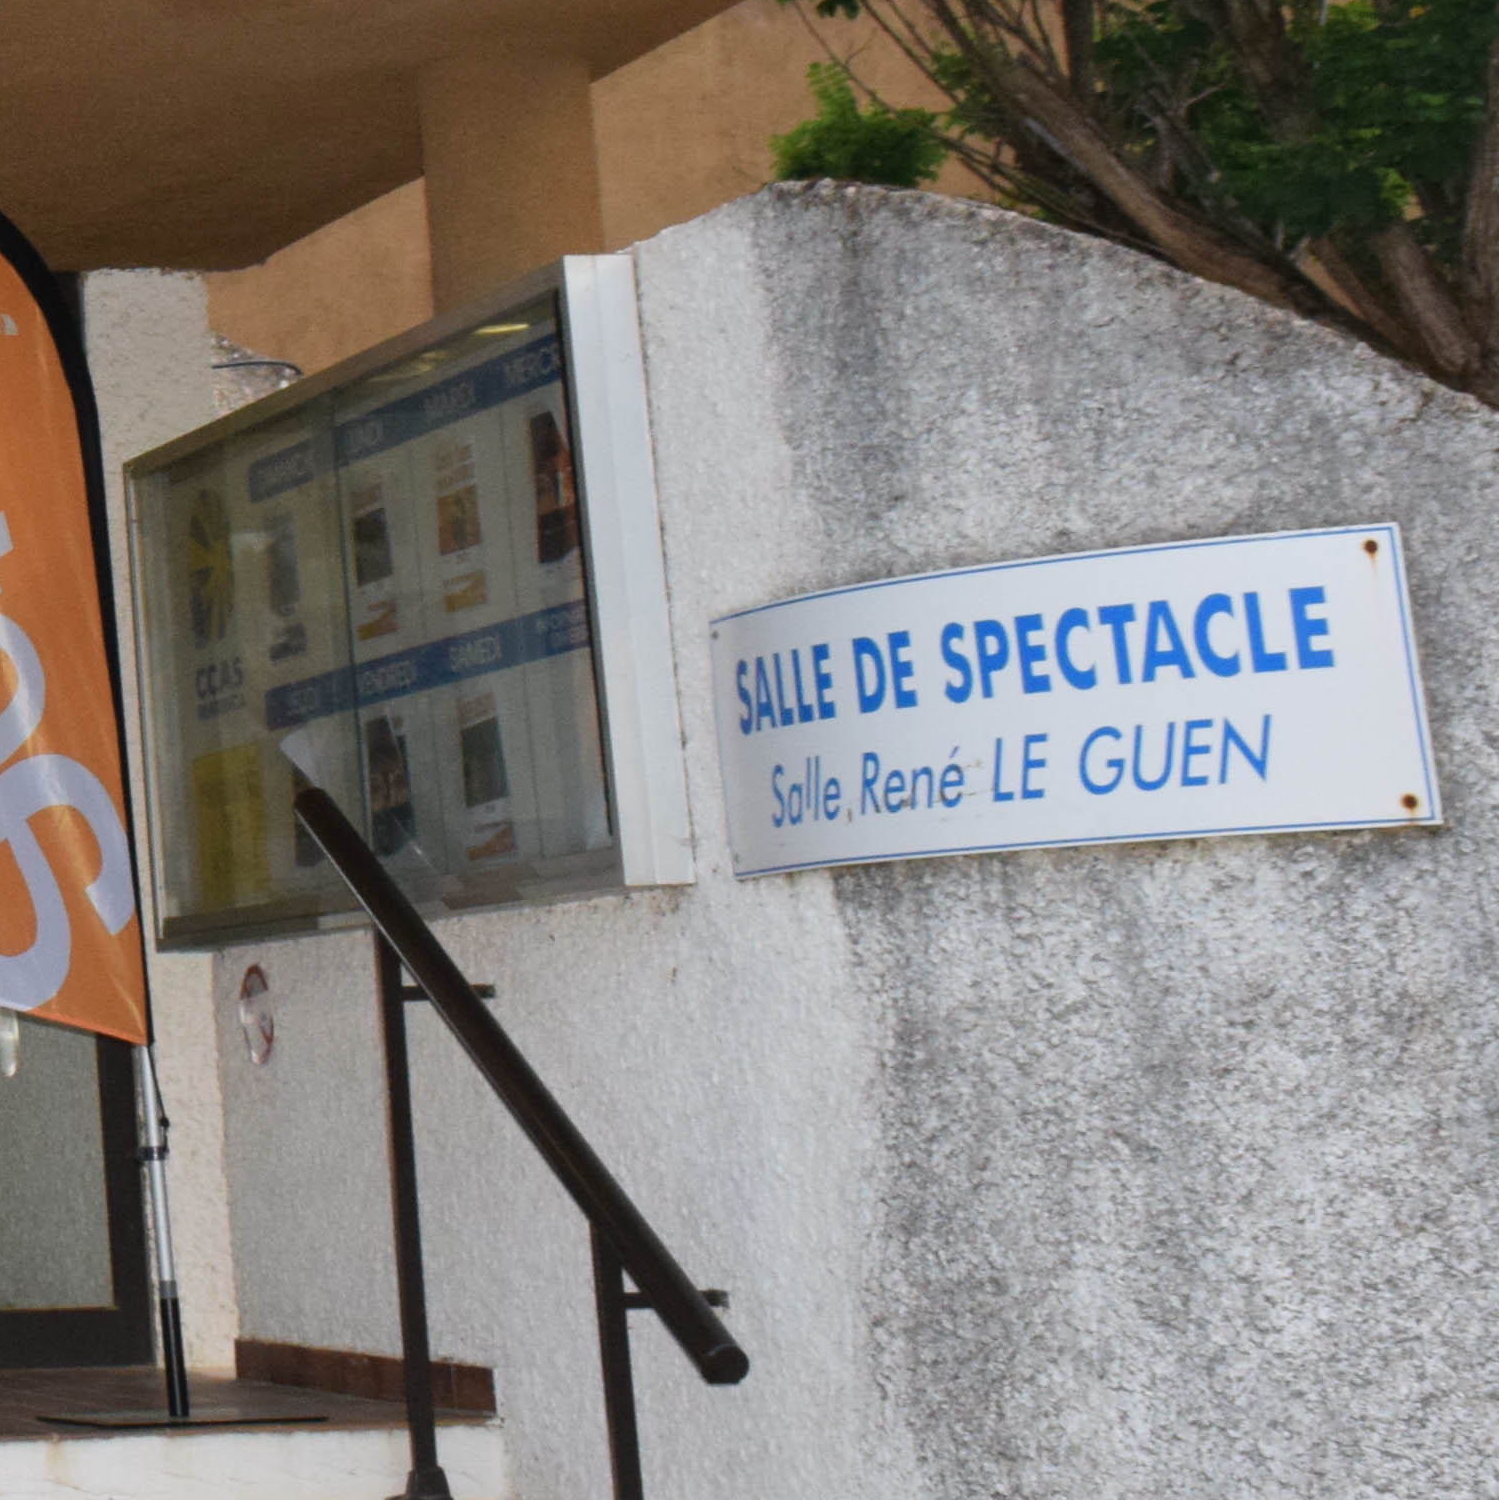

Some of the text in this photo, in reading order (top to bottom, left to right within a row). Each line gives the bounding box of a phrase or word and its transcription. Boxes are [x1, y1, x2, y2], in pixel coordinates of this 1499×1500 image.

[736, 586, 1336, 735] SALLE DE SPECTACLE
[771, 715, 1273, 828] Salle René LE GUEN
